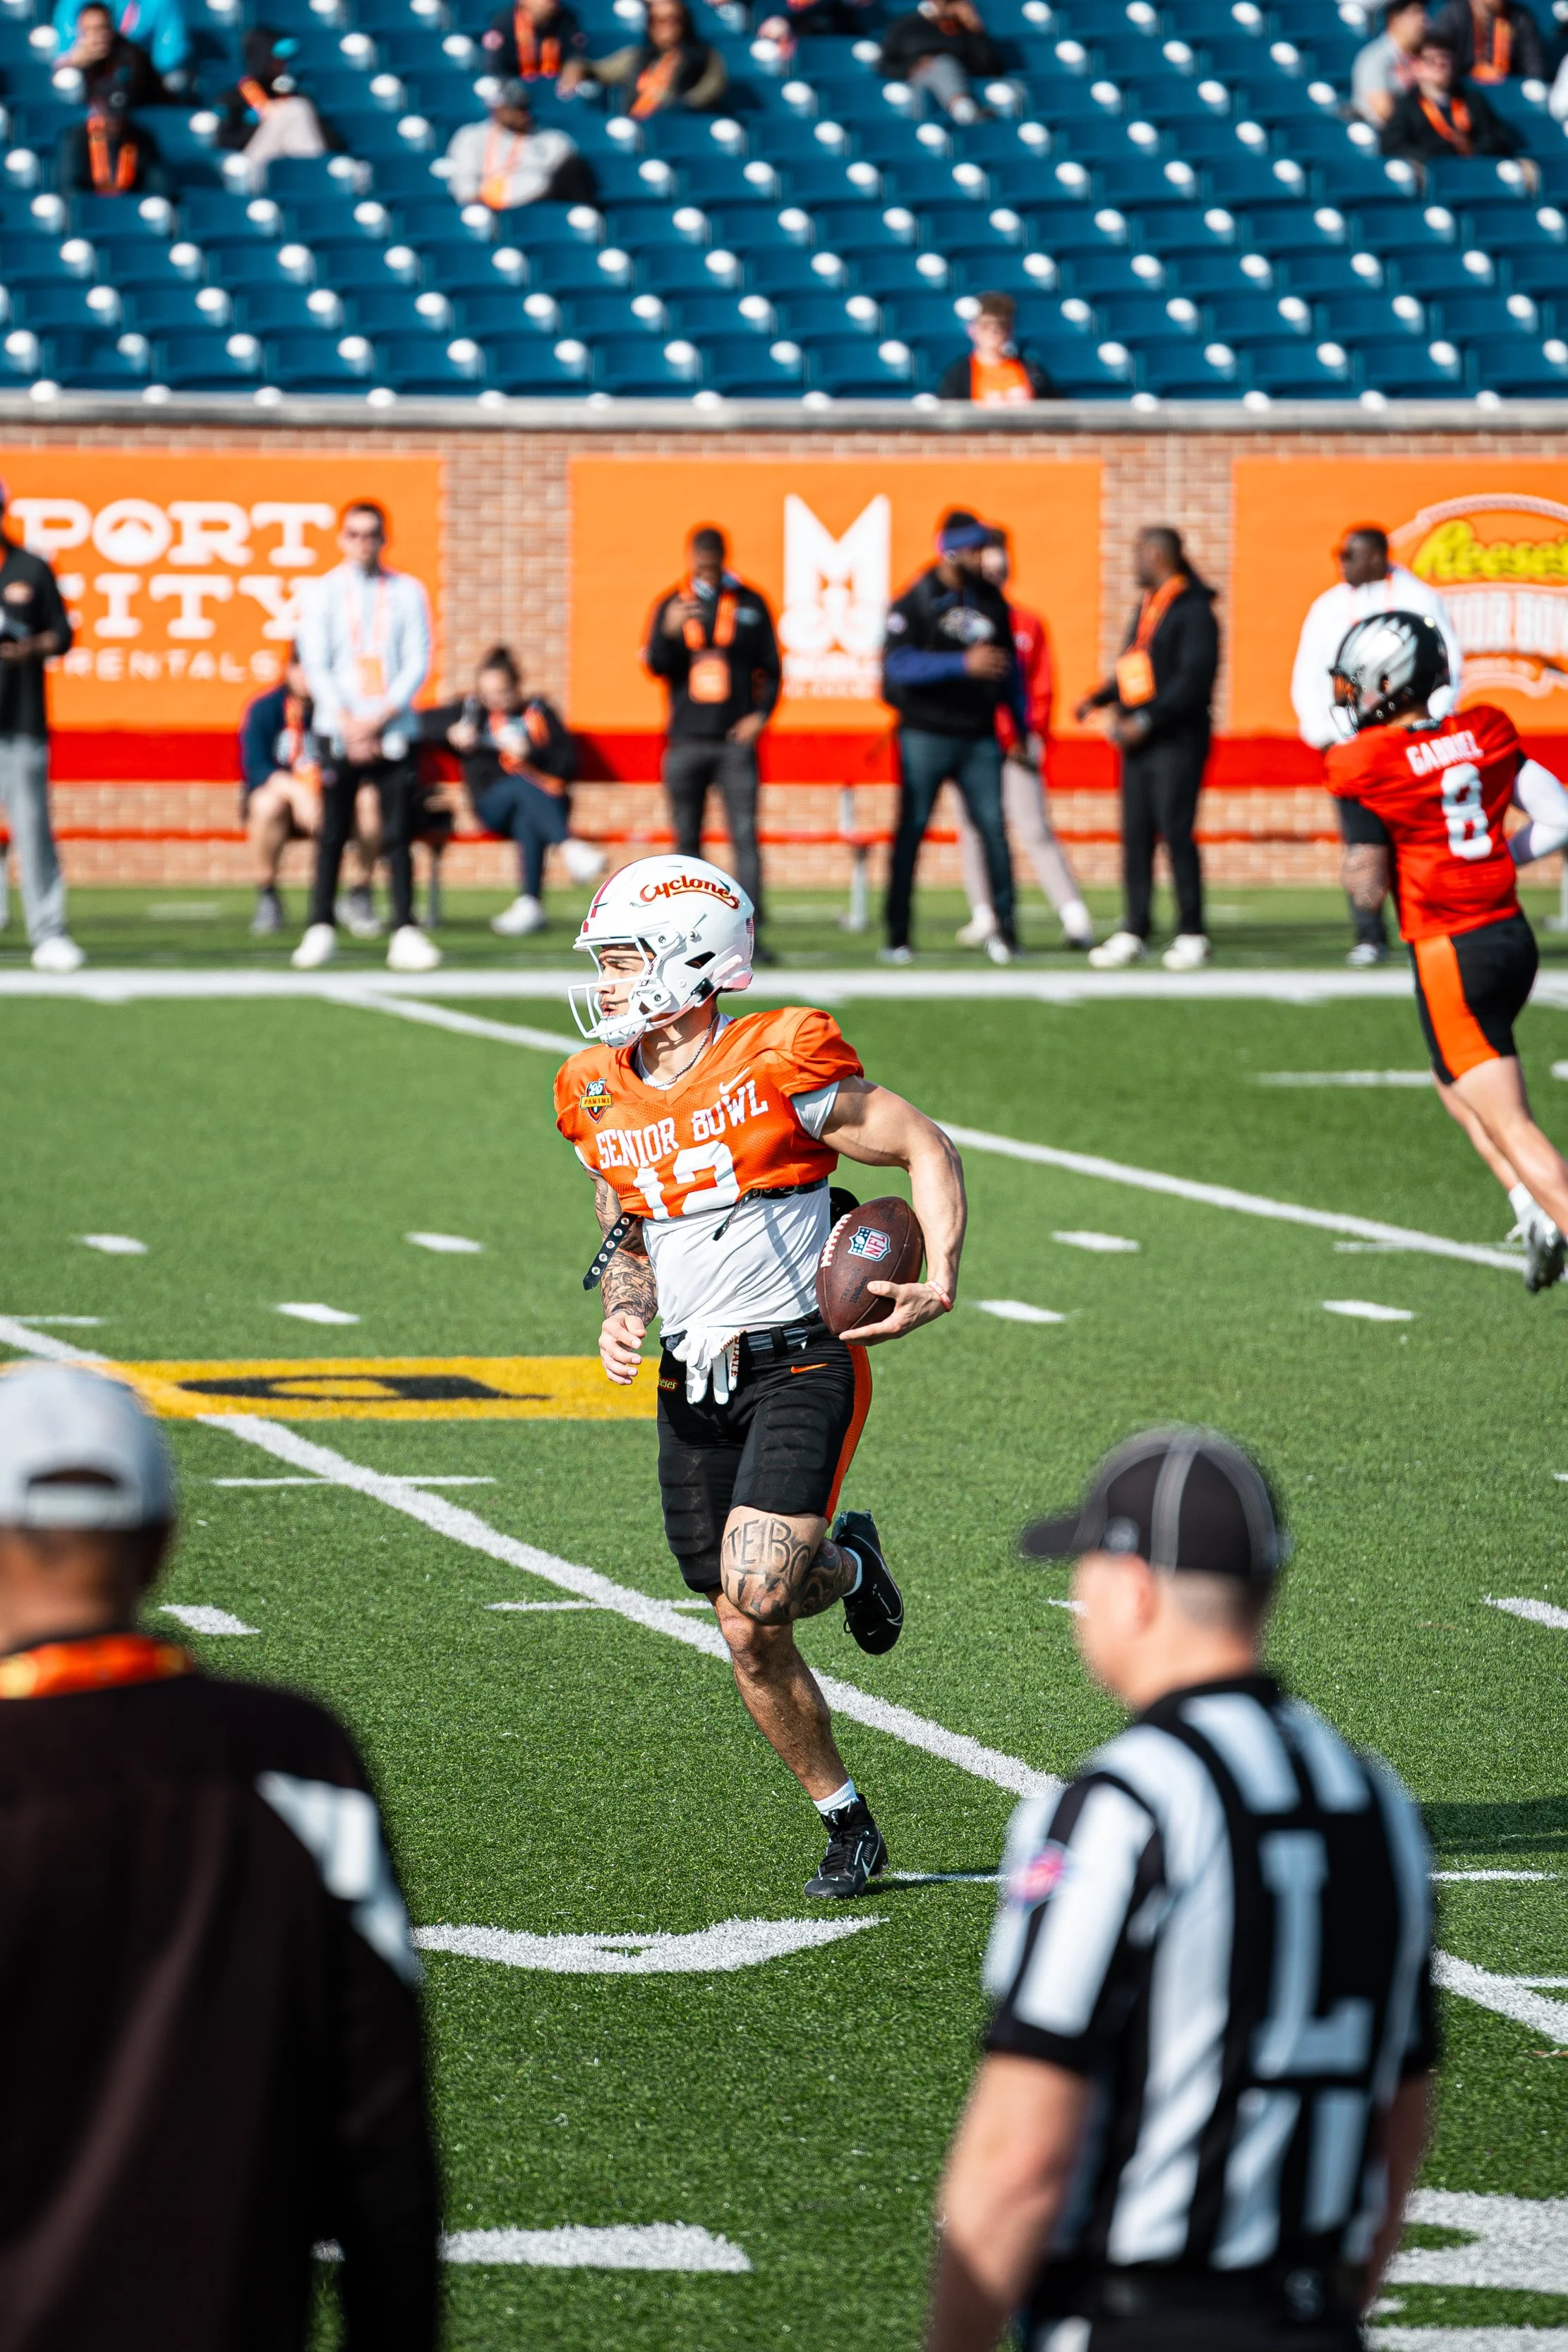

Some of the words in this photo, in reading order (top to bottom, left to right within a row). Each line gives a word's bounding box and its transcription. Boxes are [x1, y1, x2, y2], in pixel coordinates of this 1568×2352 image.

[9, 499, 334, 566] PORT
[1412, 519, 1568, 580] Reese'
[62, 647, 282, 682] RENTALS
[1440, 762, 1492, 860] 8
[639, 875, 740, 910] Cyclones
[595, 1116, 680, 1170] SENIOR
[691, 1079, 769, 1142] BOWL
[864, 1234, 886, 1258] NFL
[1250, 1831, 1373, 2077] L
